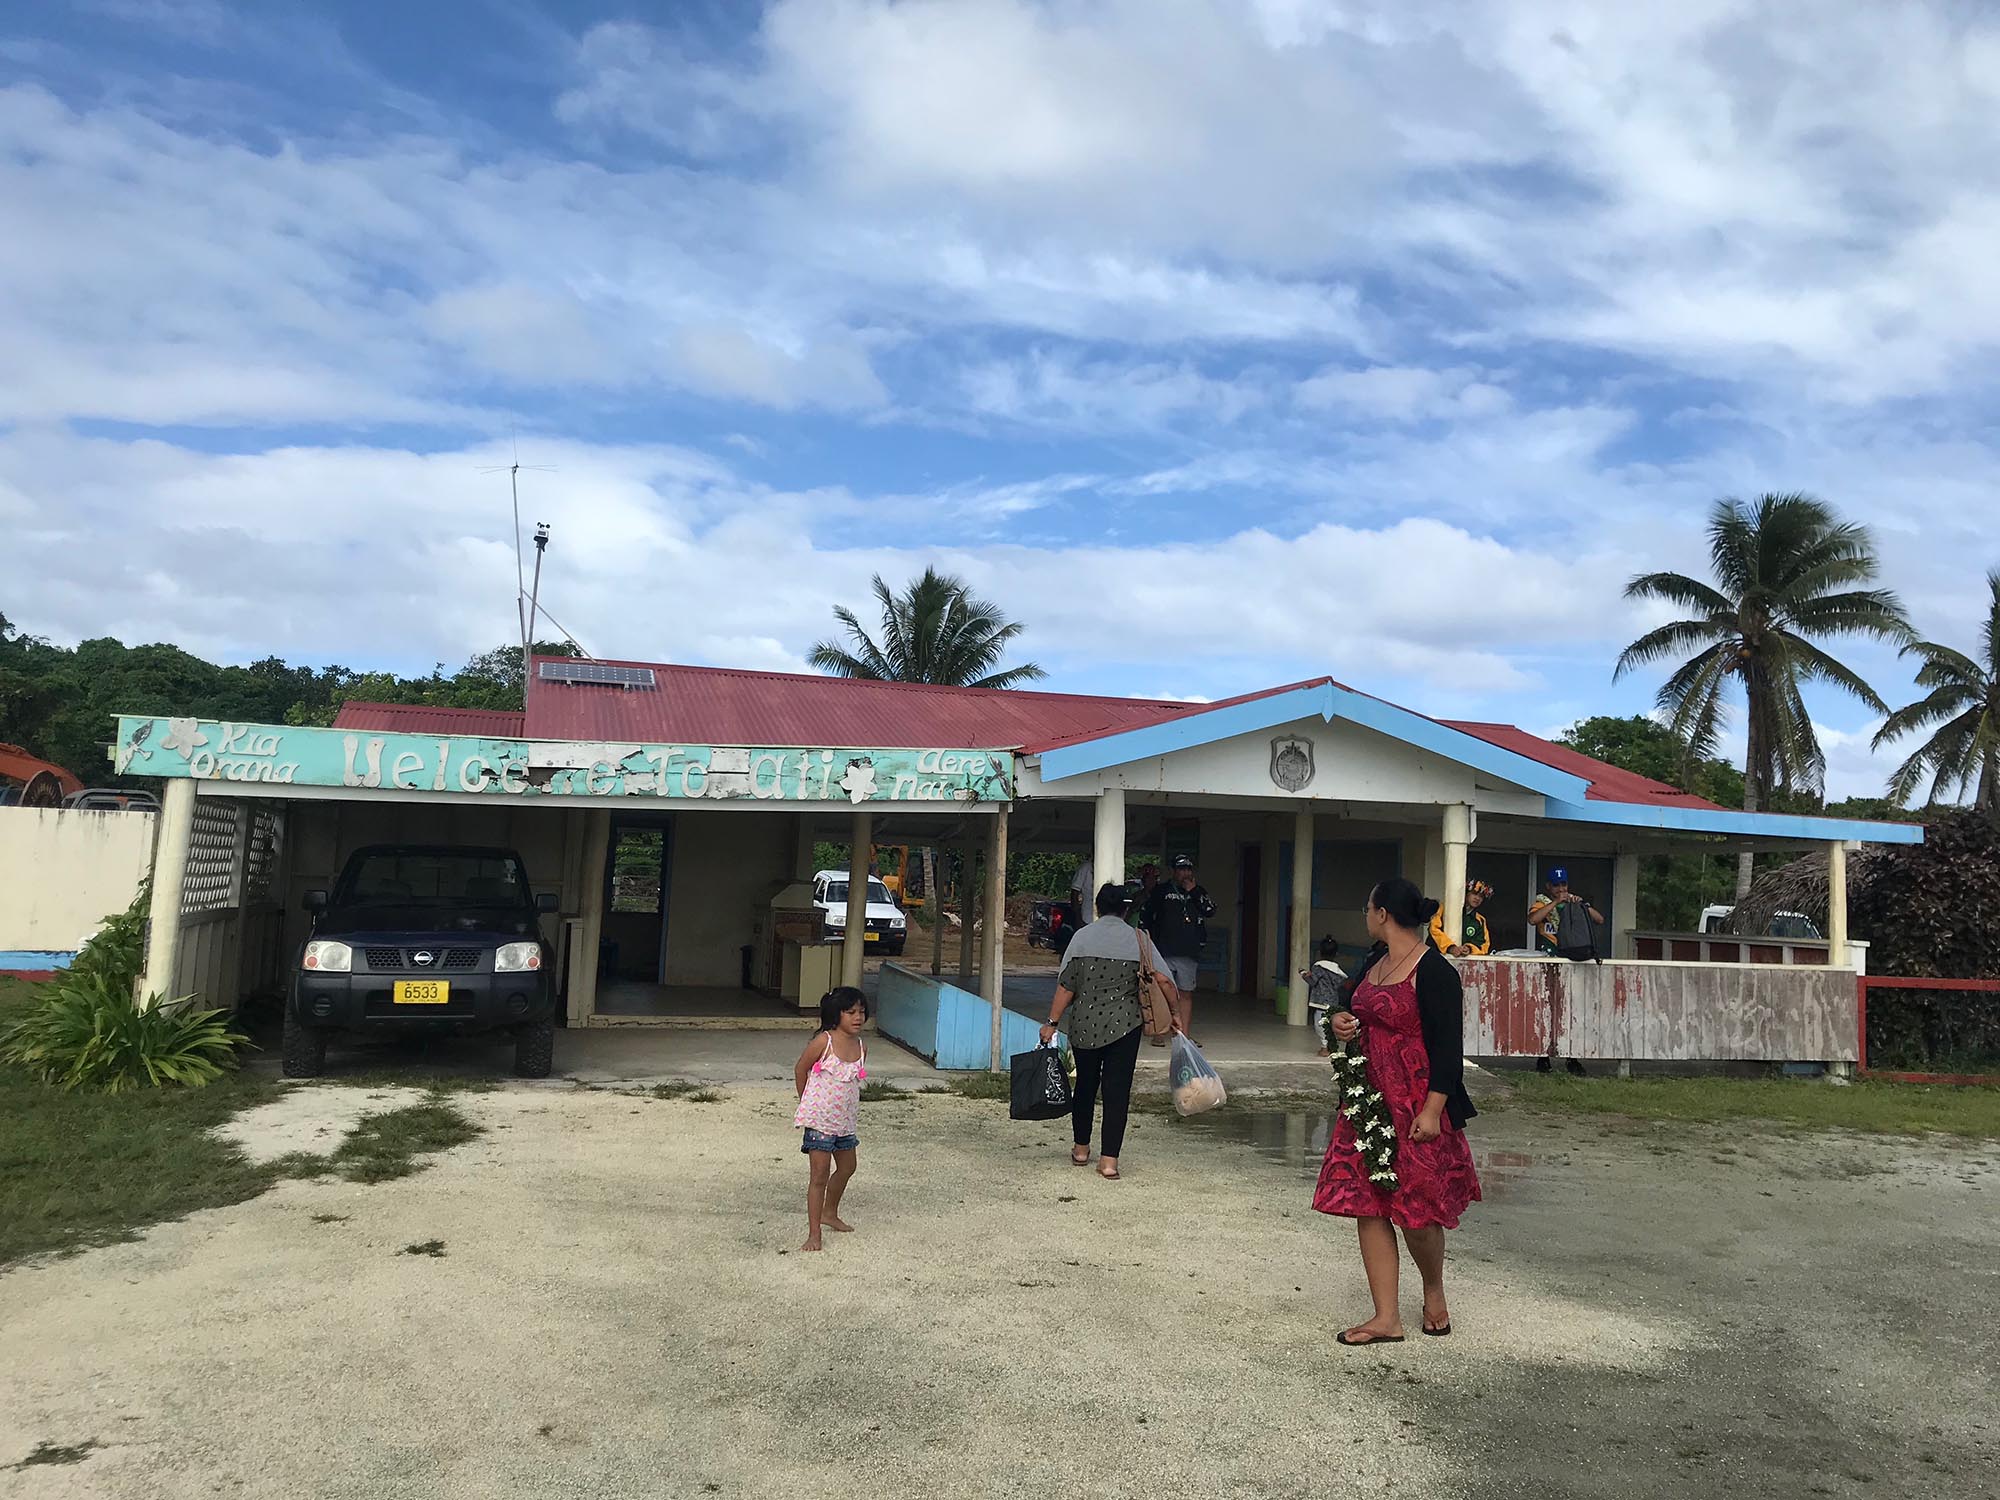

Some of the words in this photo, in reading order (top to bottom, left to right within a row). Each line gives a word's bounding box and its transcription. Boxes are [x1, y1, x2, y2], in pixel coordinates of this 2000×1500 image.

[217, 724, 283, 756] Kia
[190, 752, 300, 783] Orana
[647, 750, 709, 799] To
[1555, 869, 1563, 877] T
[404, 986, 438, 999] 6533
